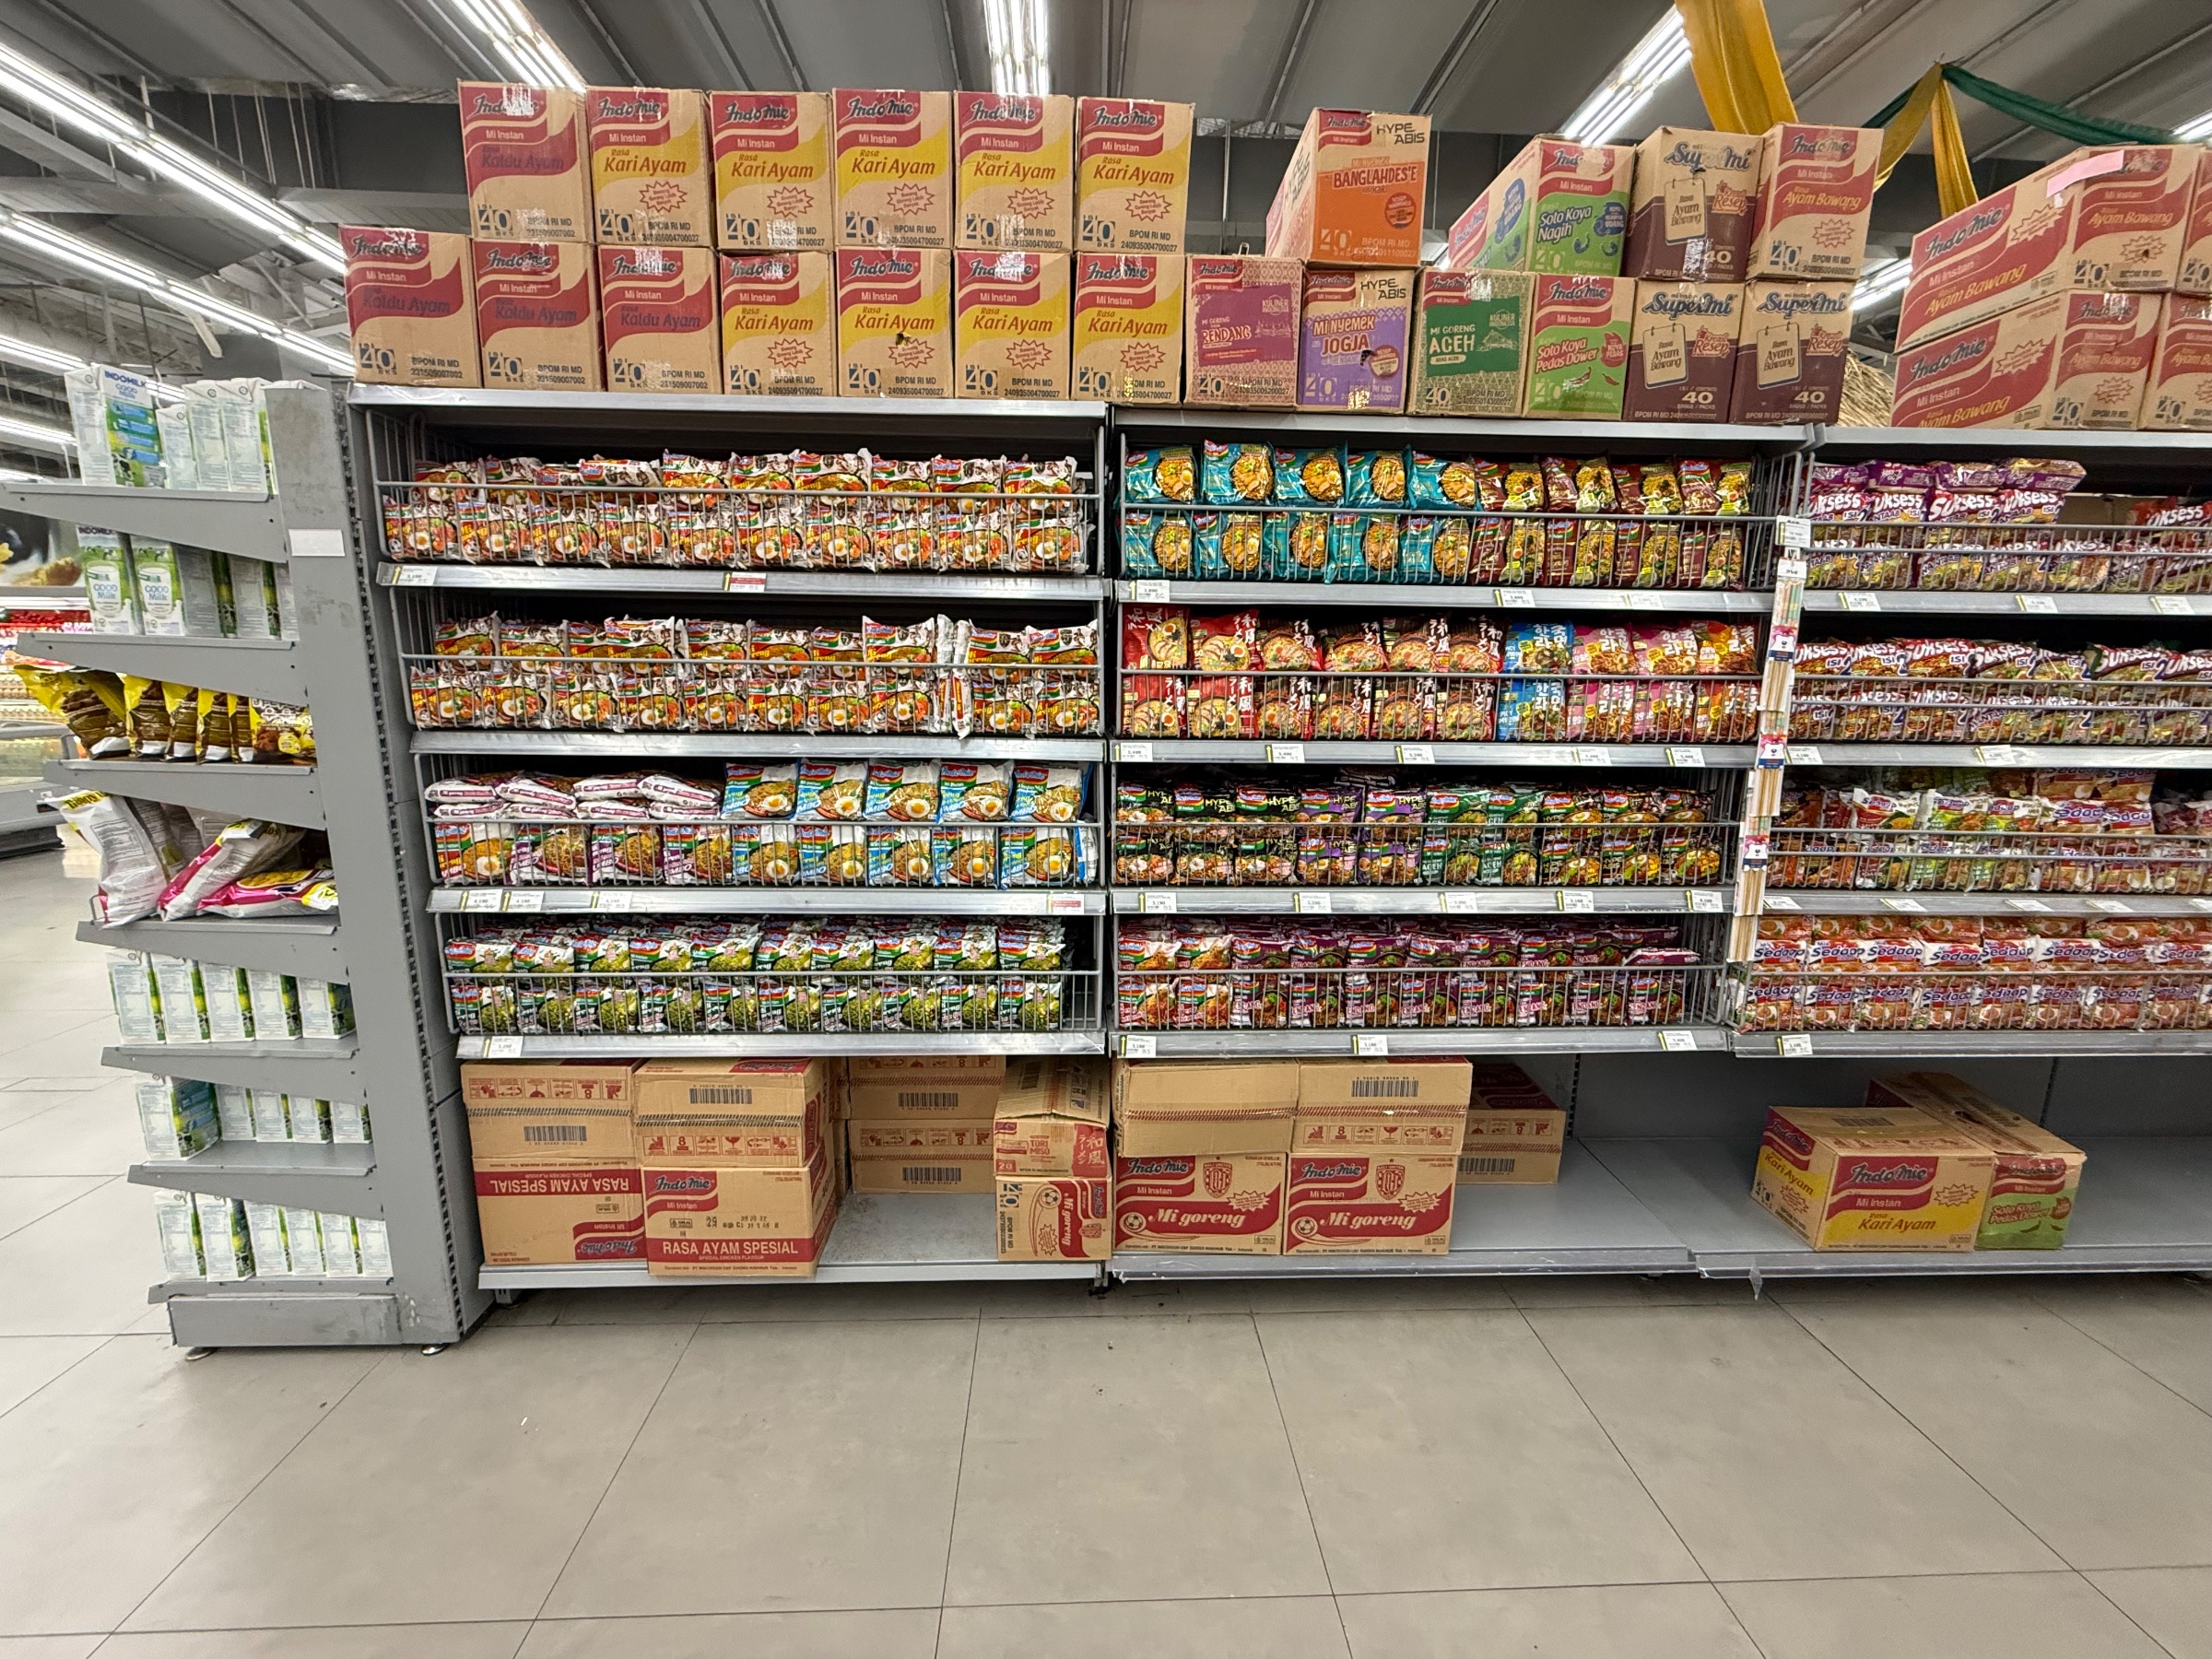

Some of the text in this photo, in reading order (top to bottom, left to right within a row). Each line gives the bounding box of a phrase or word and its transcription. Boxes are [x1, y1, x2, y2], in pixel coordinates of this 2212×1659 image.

[1377, 124, 1416, 135] HYPE
[859, 135, 897, 144] Mi Instan
[1394, 133, 1425, 144] ABIS
[1102, 142, 1139, 152] Mi Instan
[604, 157, 686, 175] Kari Ayam
[731, 162, 813, 182] Kari Ayam
[853, 158, 935, 178] Kari Ayam
[974, 161, 1055, 182] Kari Ayam
[1093, 165, 1173, 185] Kari Ayam
[1674, 201, 1699, 216] Ayam
[1783, 194, 1861, 209] Ayam Bawang
[1540, 206, 1592, 226] Soto Koya
[2088, 212, 2172, 227] Ayam Bawang
[1129, 230, 1171, 241] BPOM RI MD
[1537, 222, 1572, 243] Nagih
[1941, 260, 1974, 281] Instan
[1360, 278, 1398, 289] HYPE
[1924, 264, 2027, 315] Ayam Bawang
[625, 290, 662, 300] Mi Instan
[862, 292, 898, 301] Mi Instan
[1378, 289, 1406, 300] ABIS
[735, 315, 813, 334] Kari Ayam
[855, 314, 935, 332] Kari Ayam
[973, 315, 1053, 335] Kari Ayam
[1088, 317, 1167, 337] Kari Ayam
[1442, 324, 1475, 334] GORENG
[1202, 325, 1252, 344] RENDANG
[1322, 334, 1370, 355] JOGJA
[1430, 335, 1475, 354] ACEH
[1538, 338, 1586, 359] Soto Koya
[1696, 340, 1728, 354] Resep
[1808, 339, 1842, 353] Resep
[1535, 348, 1598, 372] Pedas Dower
[1653, 349, 1678, 362] Ayam
[1766, 348, 1793, 361] Ayam
[1012, 378, 1031, 386] BPOM
[888, 387, 944, 395] 240935004700027
[1005, 388, 1060, 397] 240935004700027
[1682, 392, 1713, 403] 40
[1794, 392, 1825, 403] 40
[1952, 396, 2009, 423] Bawang
[1812, 947, 1865, 958] Sedaap
[1868, 947, 1922, 958] Sedaap
[1078, 1135, 1087, 1164] ラーメン
[1088, 1134, 1105, 1165] 和風
[1764, 1153, 1814, 1195] Kari Ayam
[490, 1178, 629, 1194] RASA AYAM SPESIAL
[1856, 1198, 1900, 1207] Mi Instan
[1148, 1209, 1245, 1227] Mi goreng
[1320, 1212, 1417, 1230] Mi goreng
[1062, 1206, 1072, 1246] goreng
[1859, 1219, 1936, 1233] Kari Ayam
[663, 1241, 798, 1254] RASA AYAM SPESIAL
